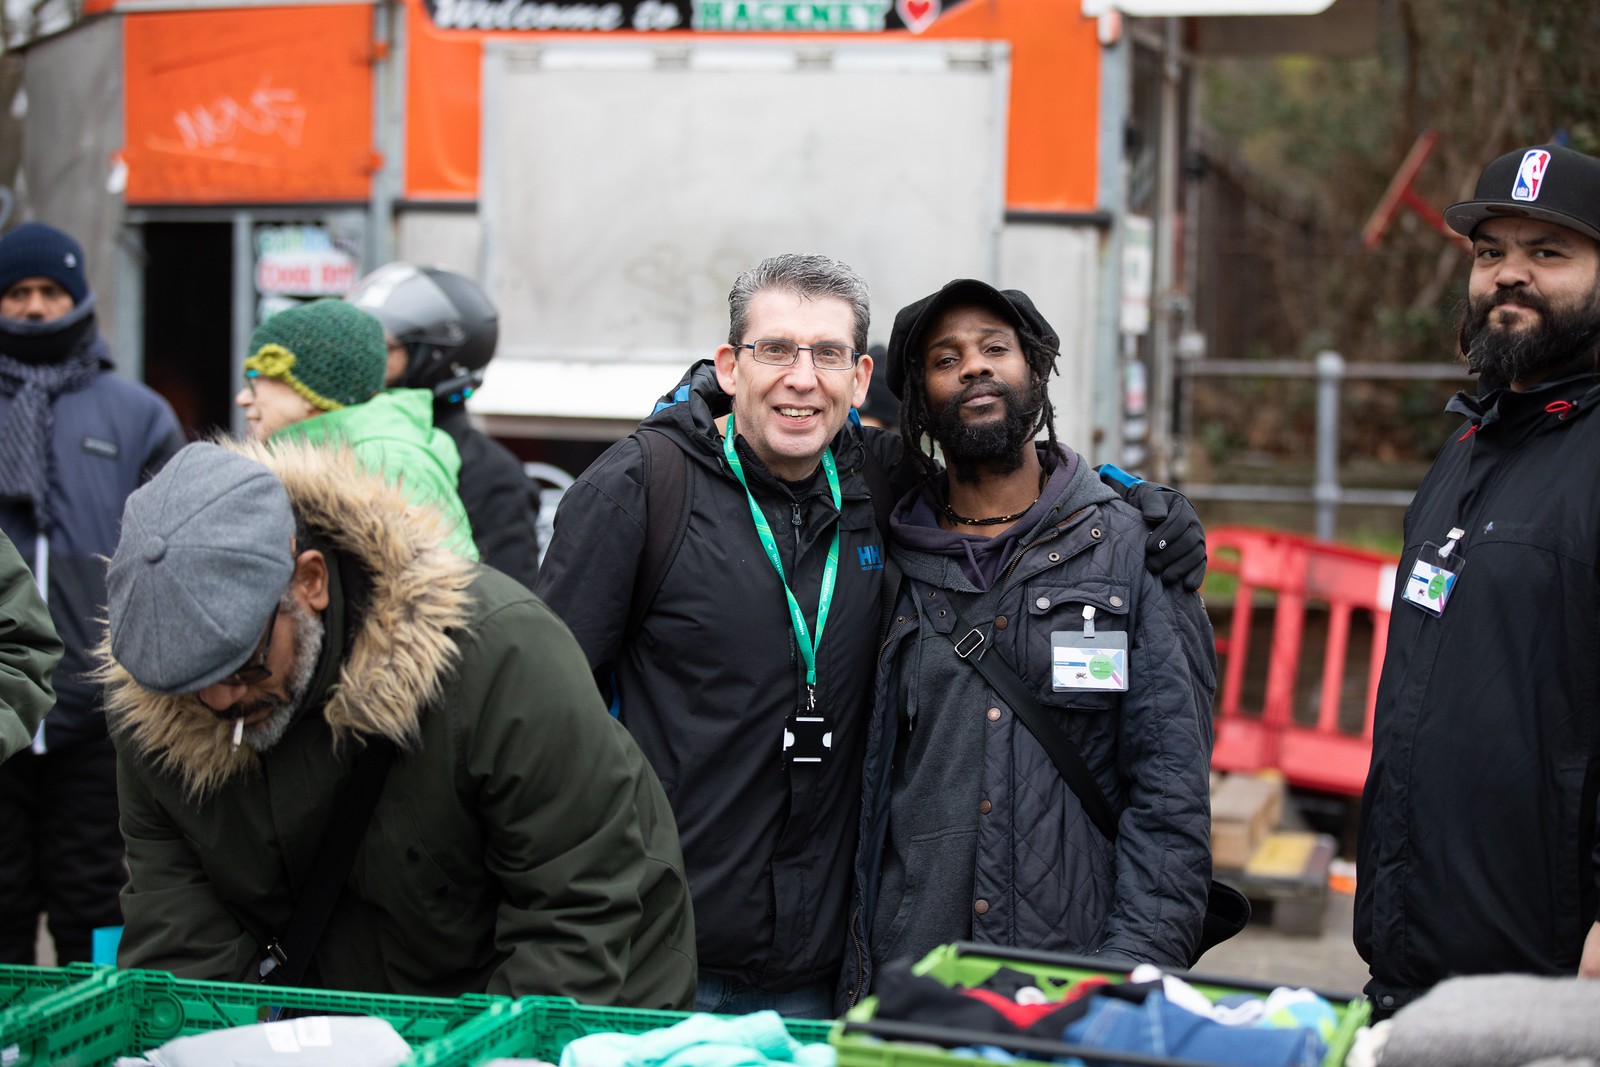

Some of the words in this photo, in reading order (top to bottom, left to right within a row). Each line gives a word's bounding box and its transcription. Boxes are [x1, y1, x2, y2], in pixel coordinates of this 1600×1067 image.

[434, 0, 623, 30] Welcome
[632, 0, 680, 30] to
[696, 0, 884, 31] HACKNEY
[857, 545, 881, 566] HH
